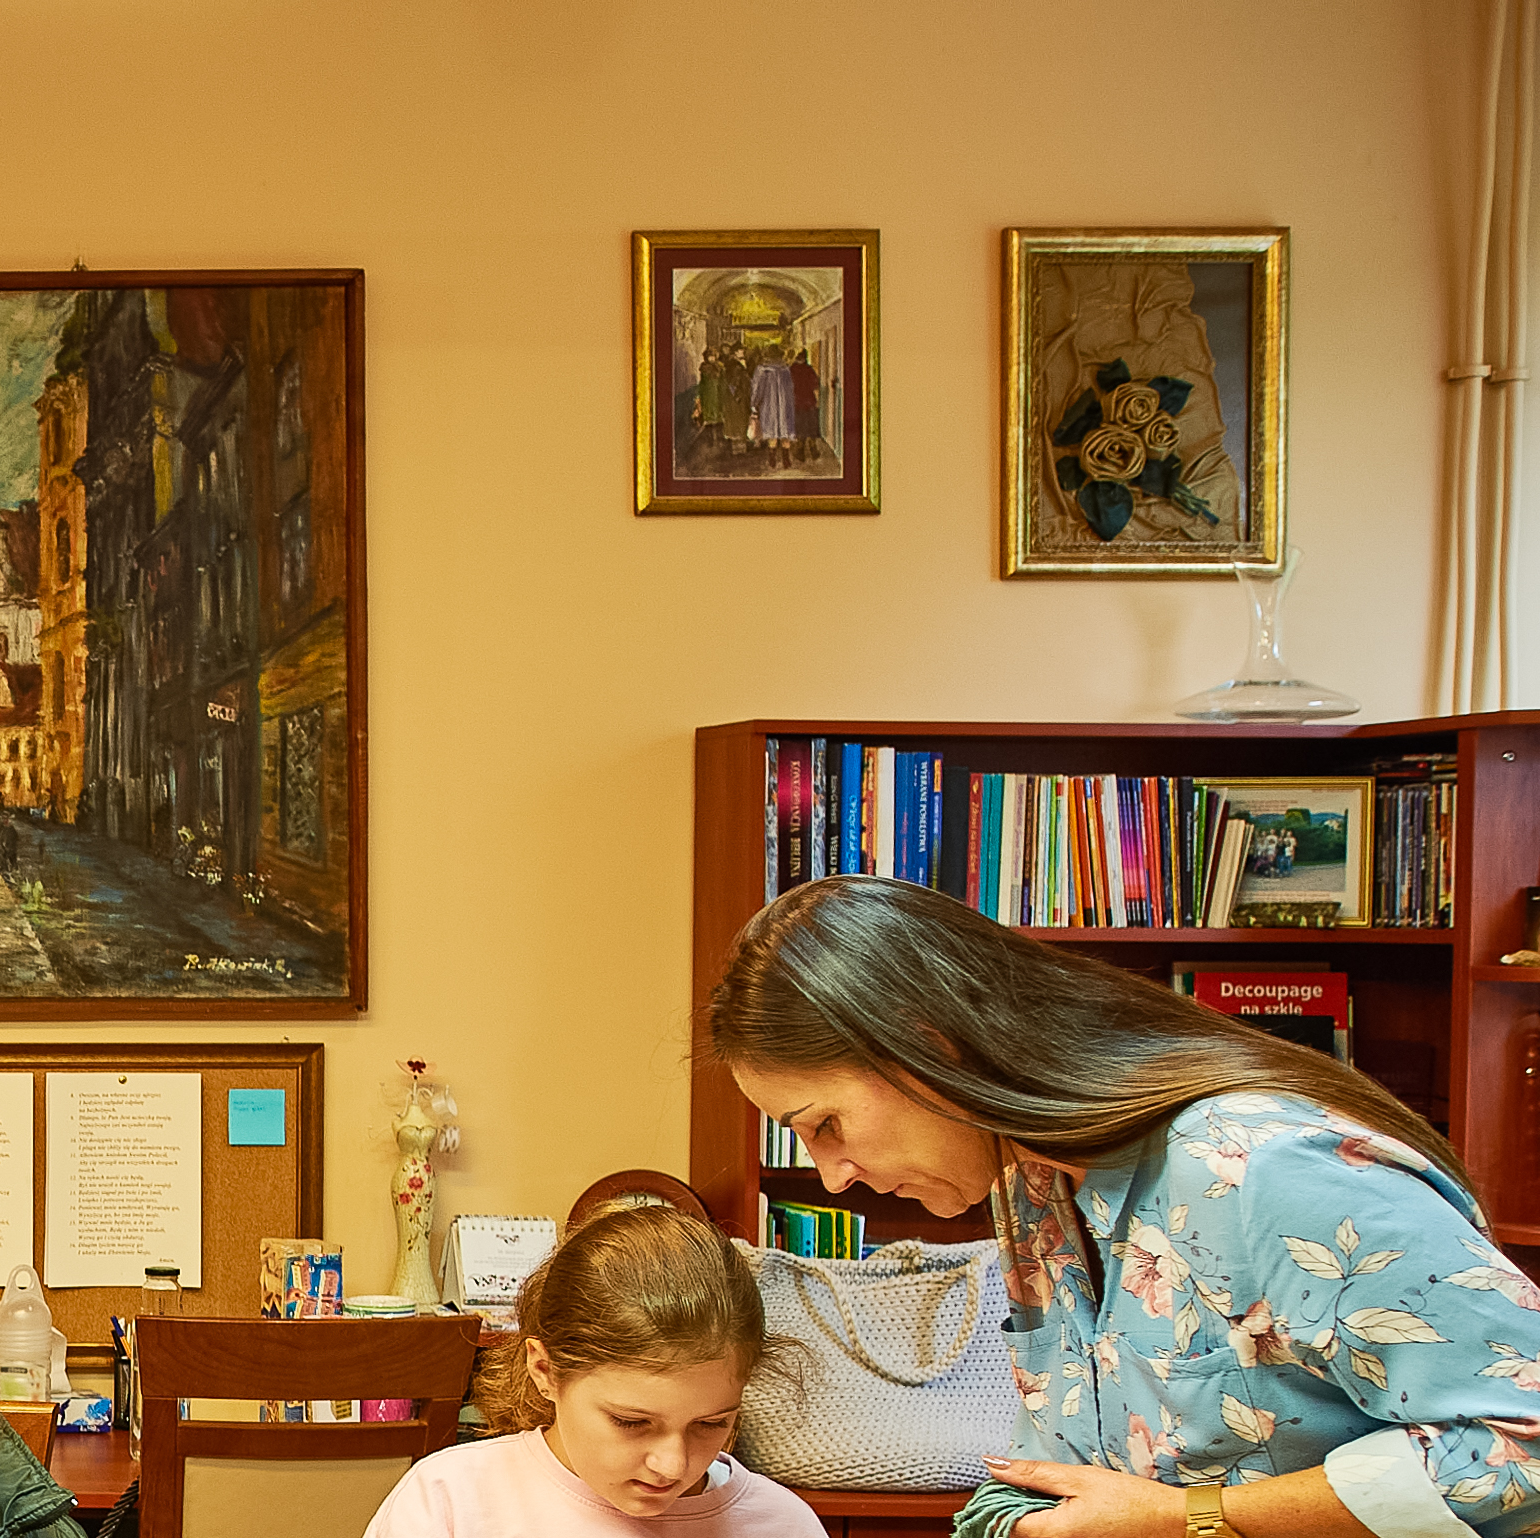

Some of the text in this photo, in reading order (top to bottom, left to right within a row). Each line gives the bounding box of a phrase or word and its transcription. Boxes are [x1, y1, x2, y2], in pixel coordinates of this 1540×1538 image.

[1220, 982, 1323, 1001] Decoupage
[1240, 1001, 1303, 1016] na szkle
